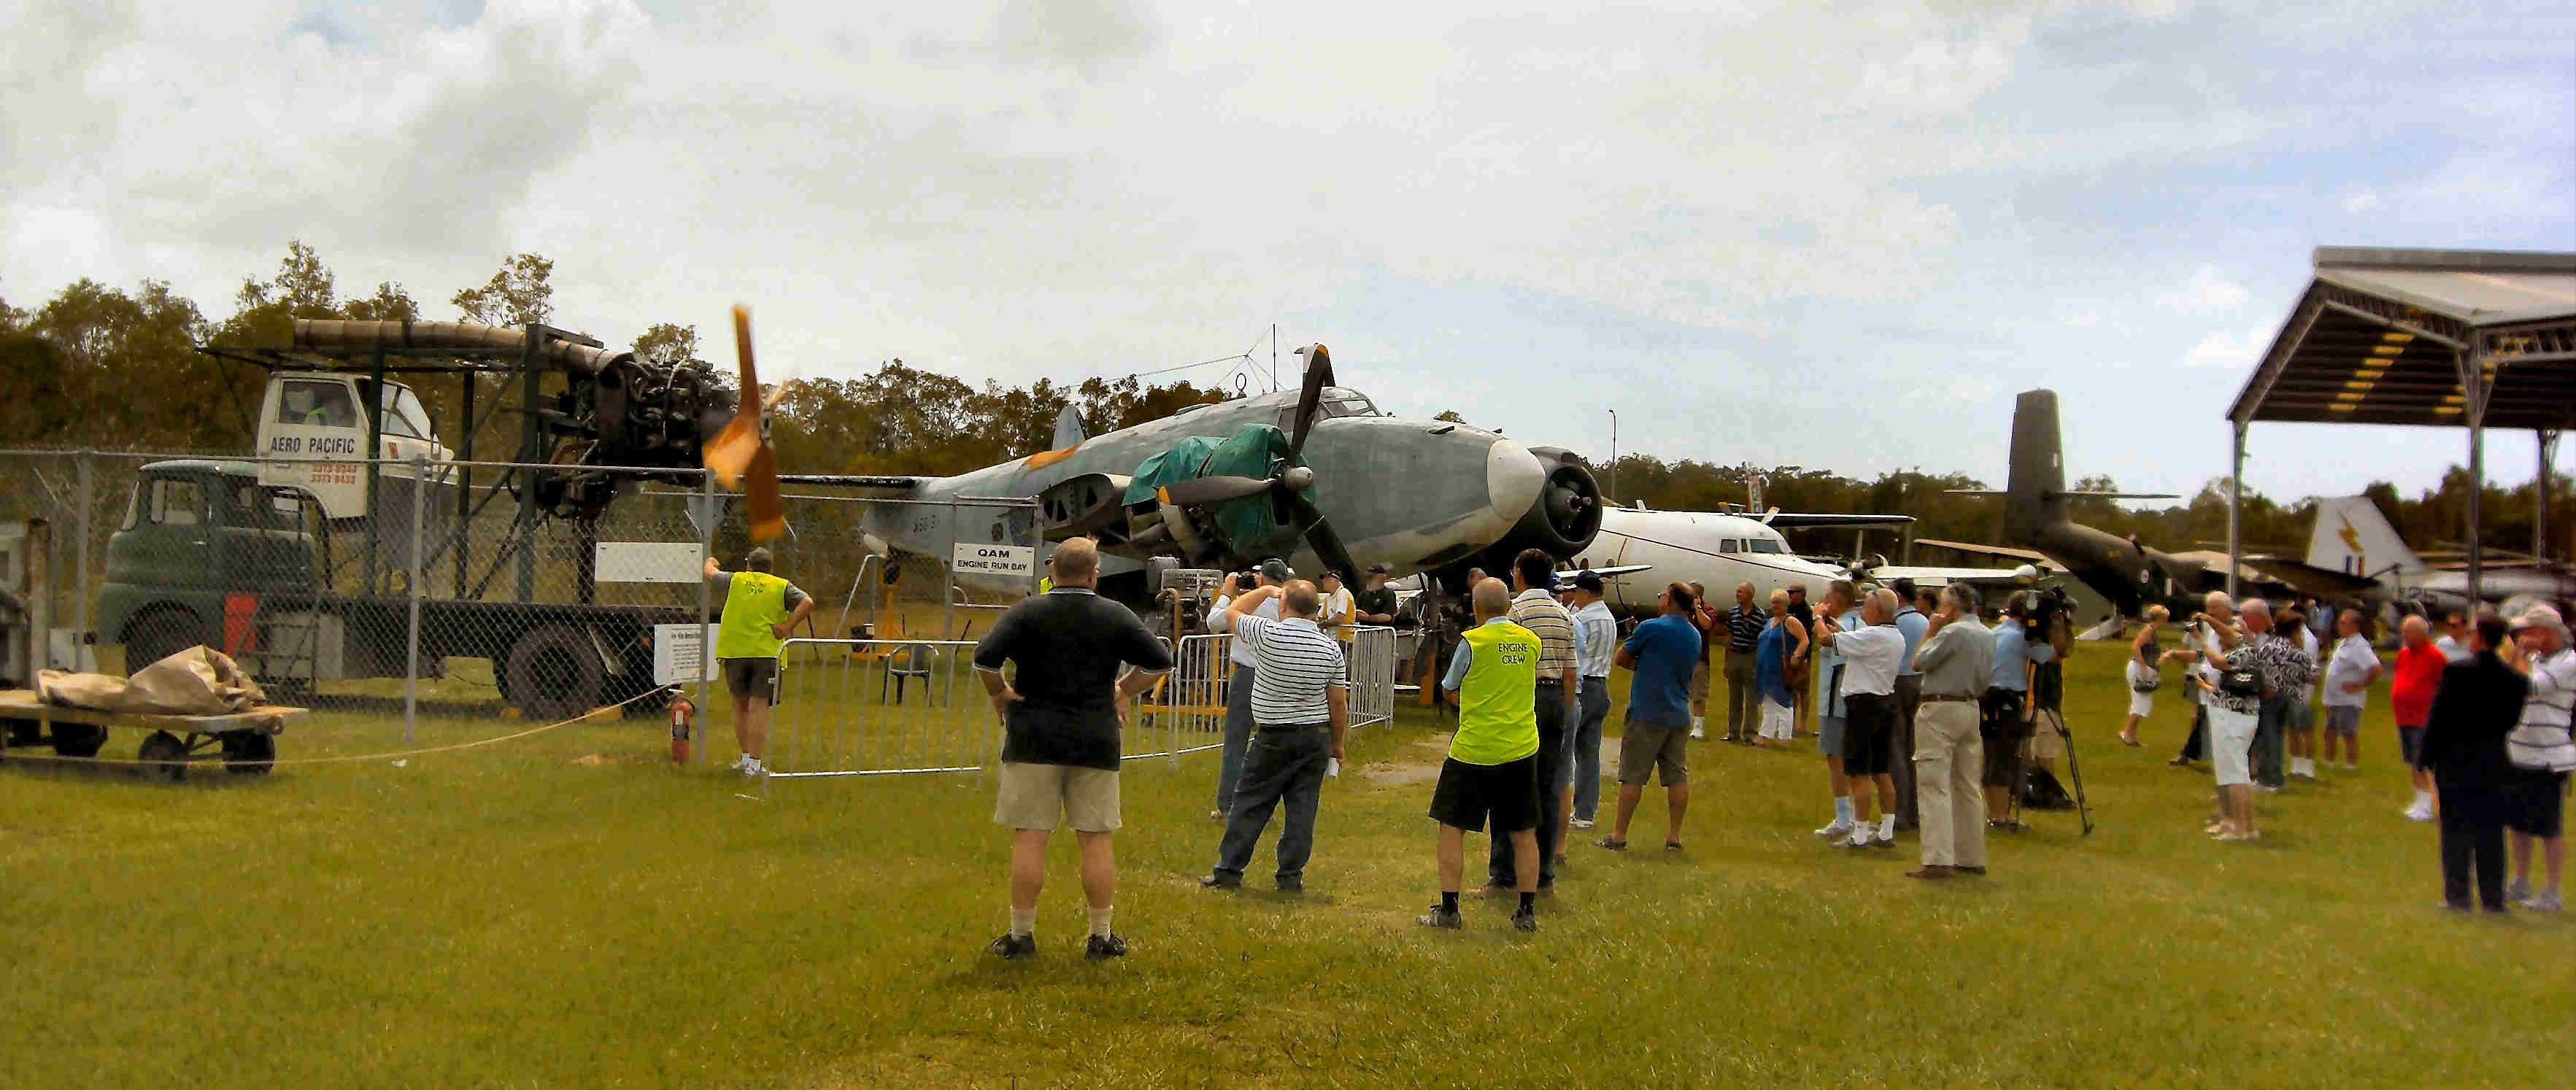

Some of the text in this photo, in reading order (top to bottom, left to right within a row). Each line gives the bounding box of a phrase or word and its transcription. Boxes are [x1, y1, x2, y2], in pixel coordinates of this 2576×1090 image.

[271, 438, 355, 453] AERO PACIFIC
[978, 549, 1010, 558] QAM
[957, 560, 988, 568] ENGINE
[1498, 643, 1528, 652] ENGINE
[1502, 655, 1525, 664] CREW
